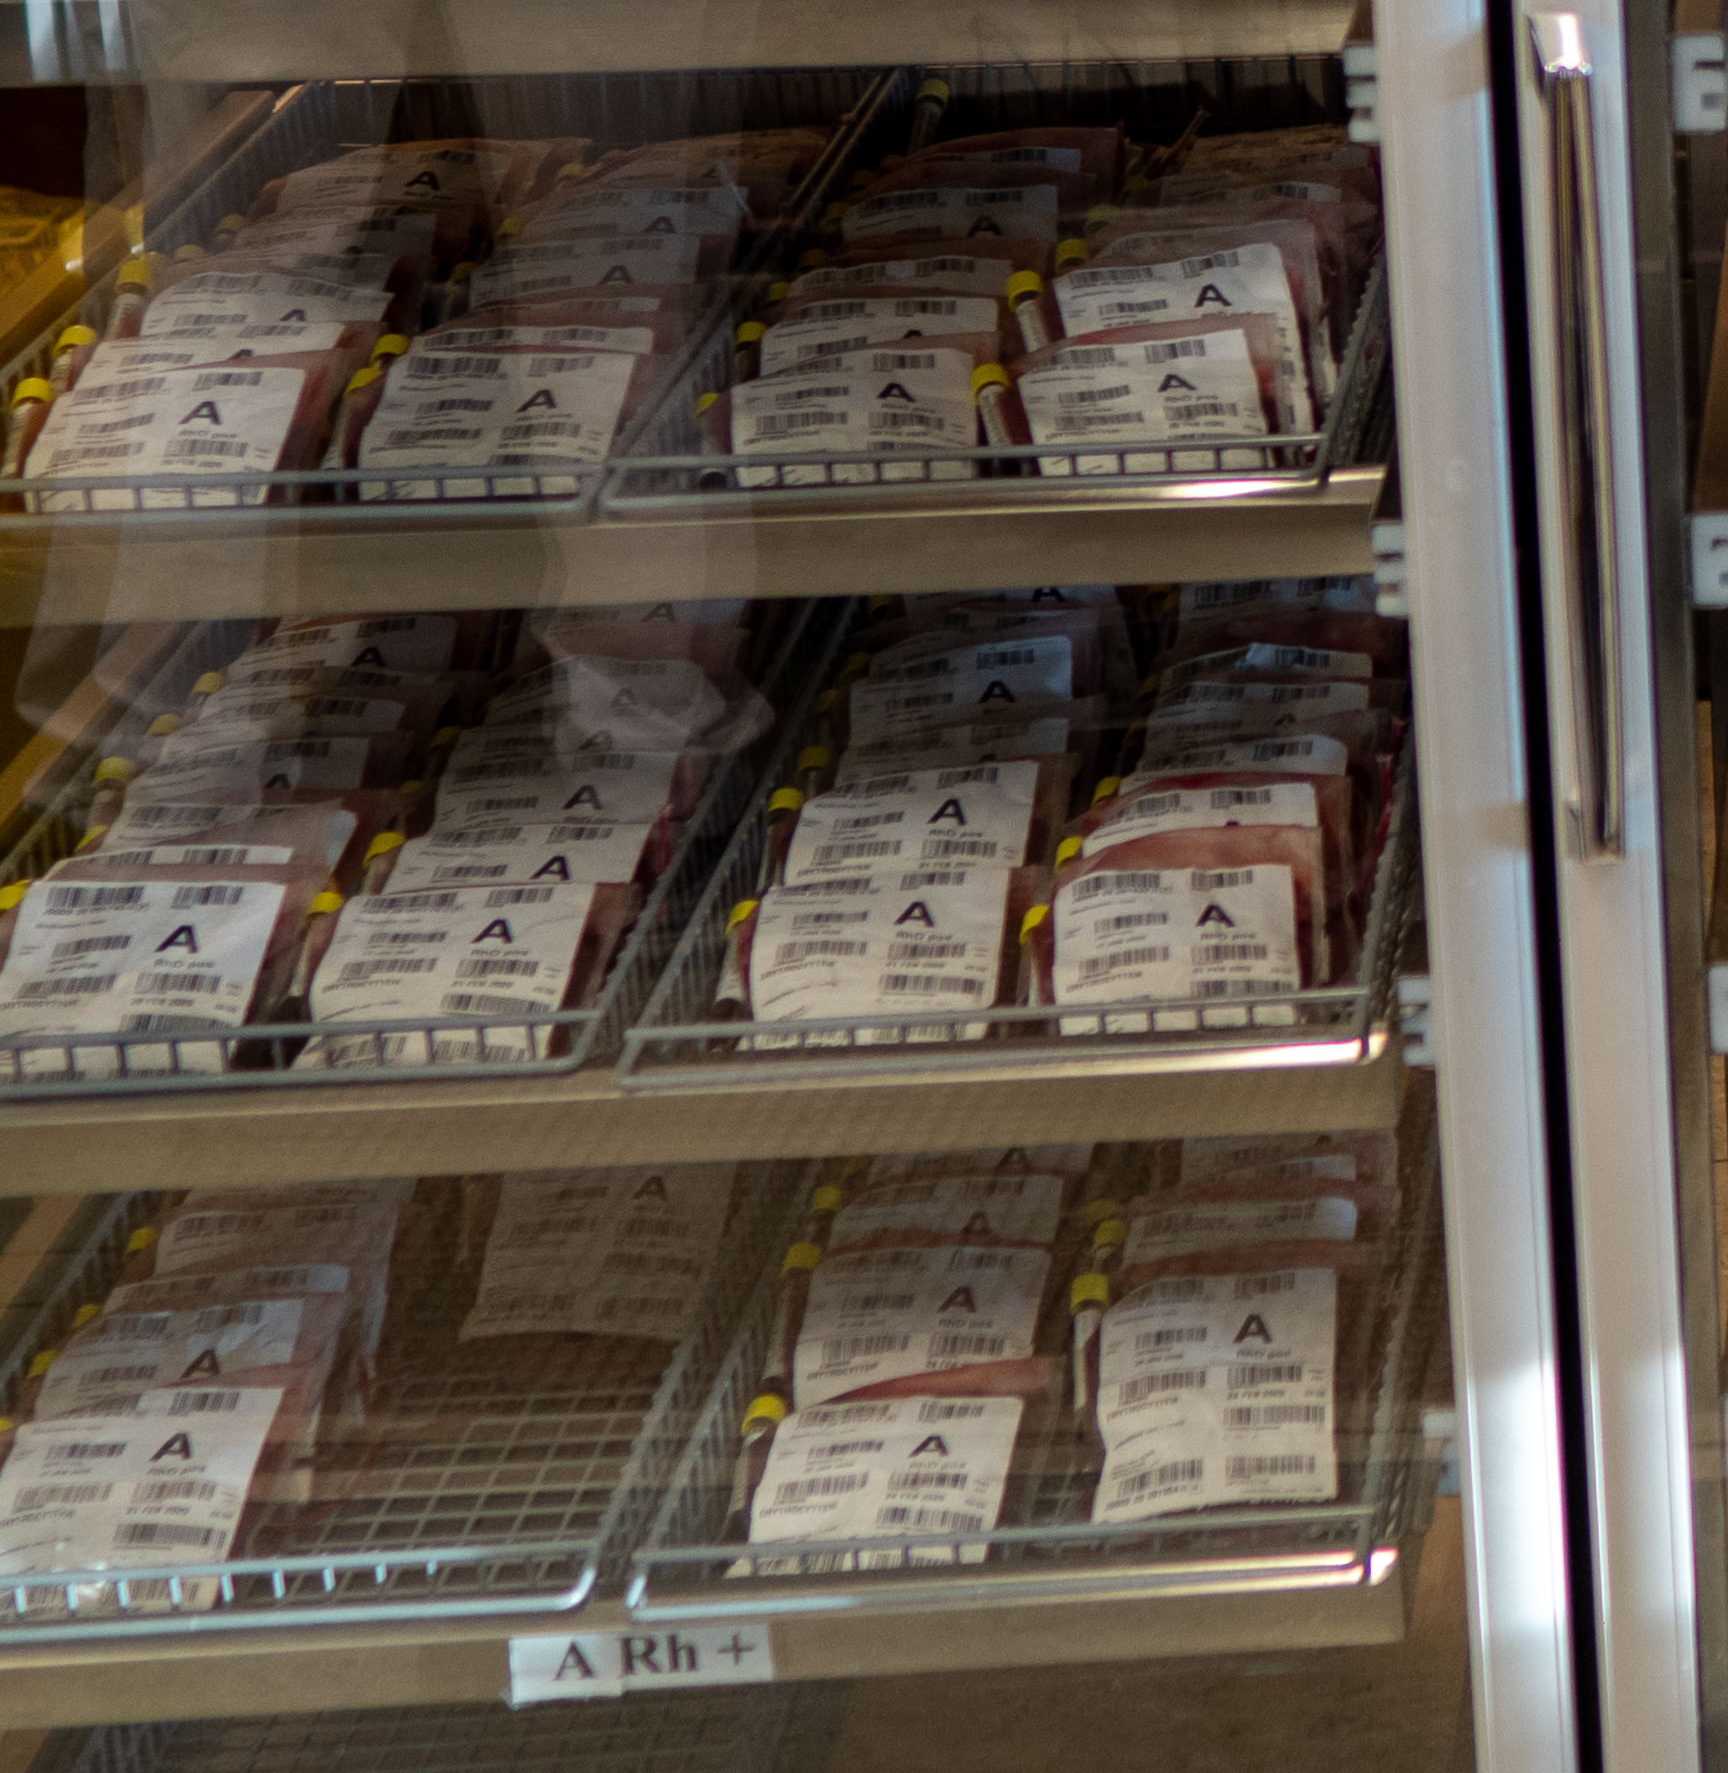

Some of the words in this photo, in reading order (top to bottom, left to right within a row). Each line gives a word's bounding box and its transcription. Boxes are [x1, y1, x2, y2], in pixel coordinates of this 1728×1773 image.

[406, 170, 442, 192] A
[966, 215, 1004, 239] A
[1195, 283, 1231, 308] A
[878, 382, 915, 403] A
[1158, 373, 1196, 393] A
[181, 400, 221, 425] A
[516, 388, 557, 413] A
[640, 602, 678, 625] A
[351, 646, 390, 669] A
[978, 680, 1018, 705] A
[263, 773, 290, 791] A
[563, 784, 602, 810] A
[929, 797, 966, 826] A
[532, 855, 570, 881] A
[895, 900, 934, 927] A
[1197, 903, 1235, 927] A
[156, 924, 198, 953] A
[473, 918, 513, 944] A
[633, 1175, 668, 1202] A
[939, 1284, 976, 1313] A
[1235, 1312, 1272, 1343] A
[181, 1348, 221, 1379] A
[151, 1432, 192, 1461] A
[911, 1434, 948, 1456] A
[553, 1639, 596, 1681] A
[616, 1633, 700, 1678] Rh
[717, 1631, 756, 1667] +
